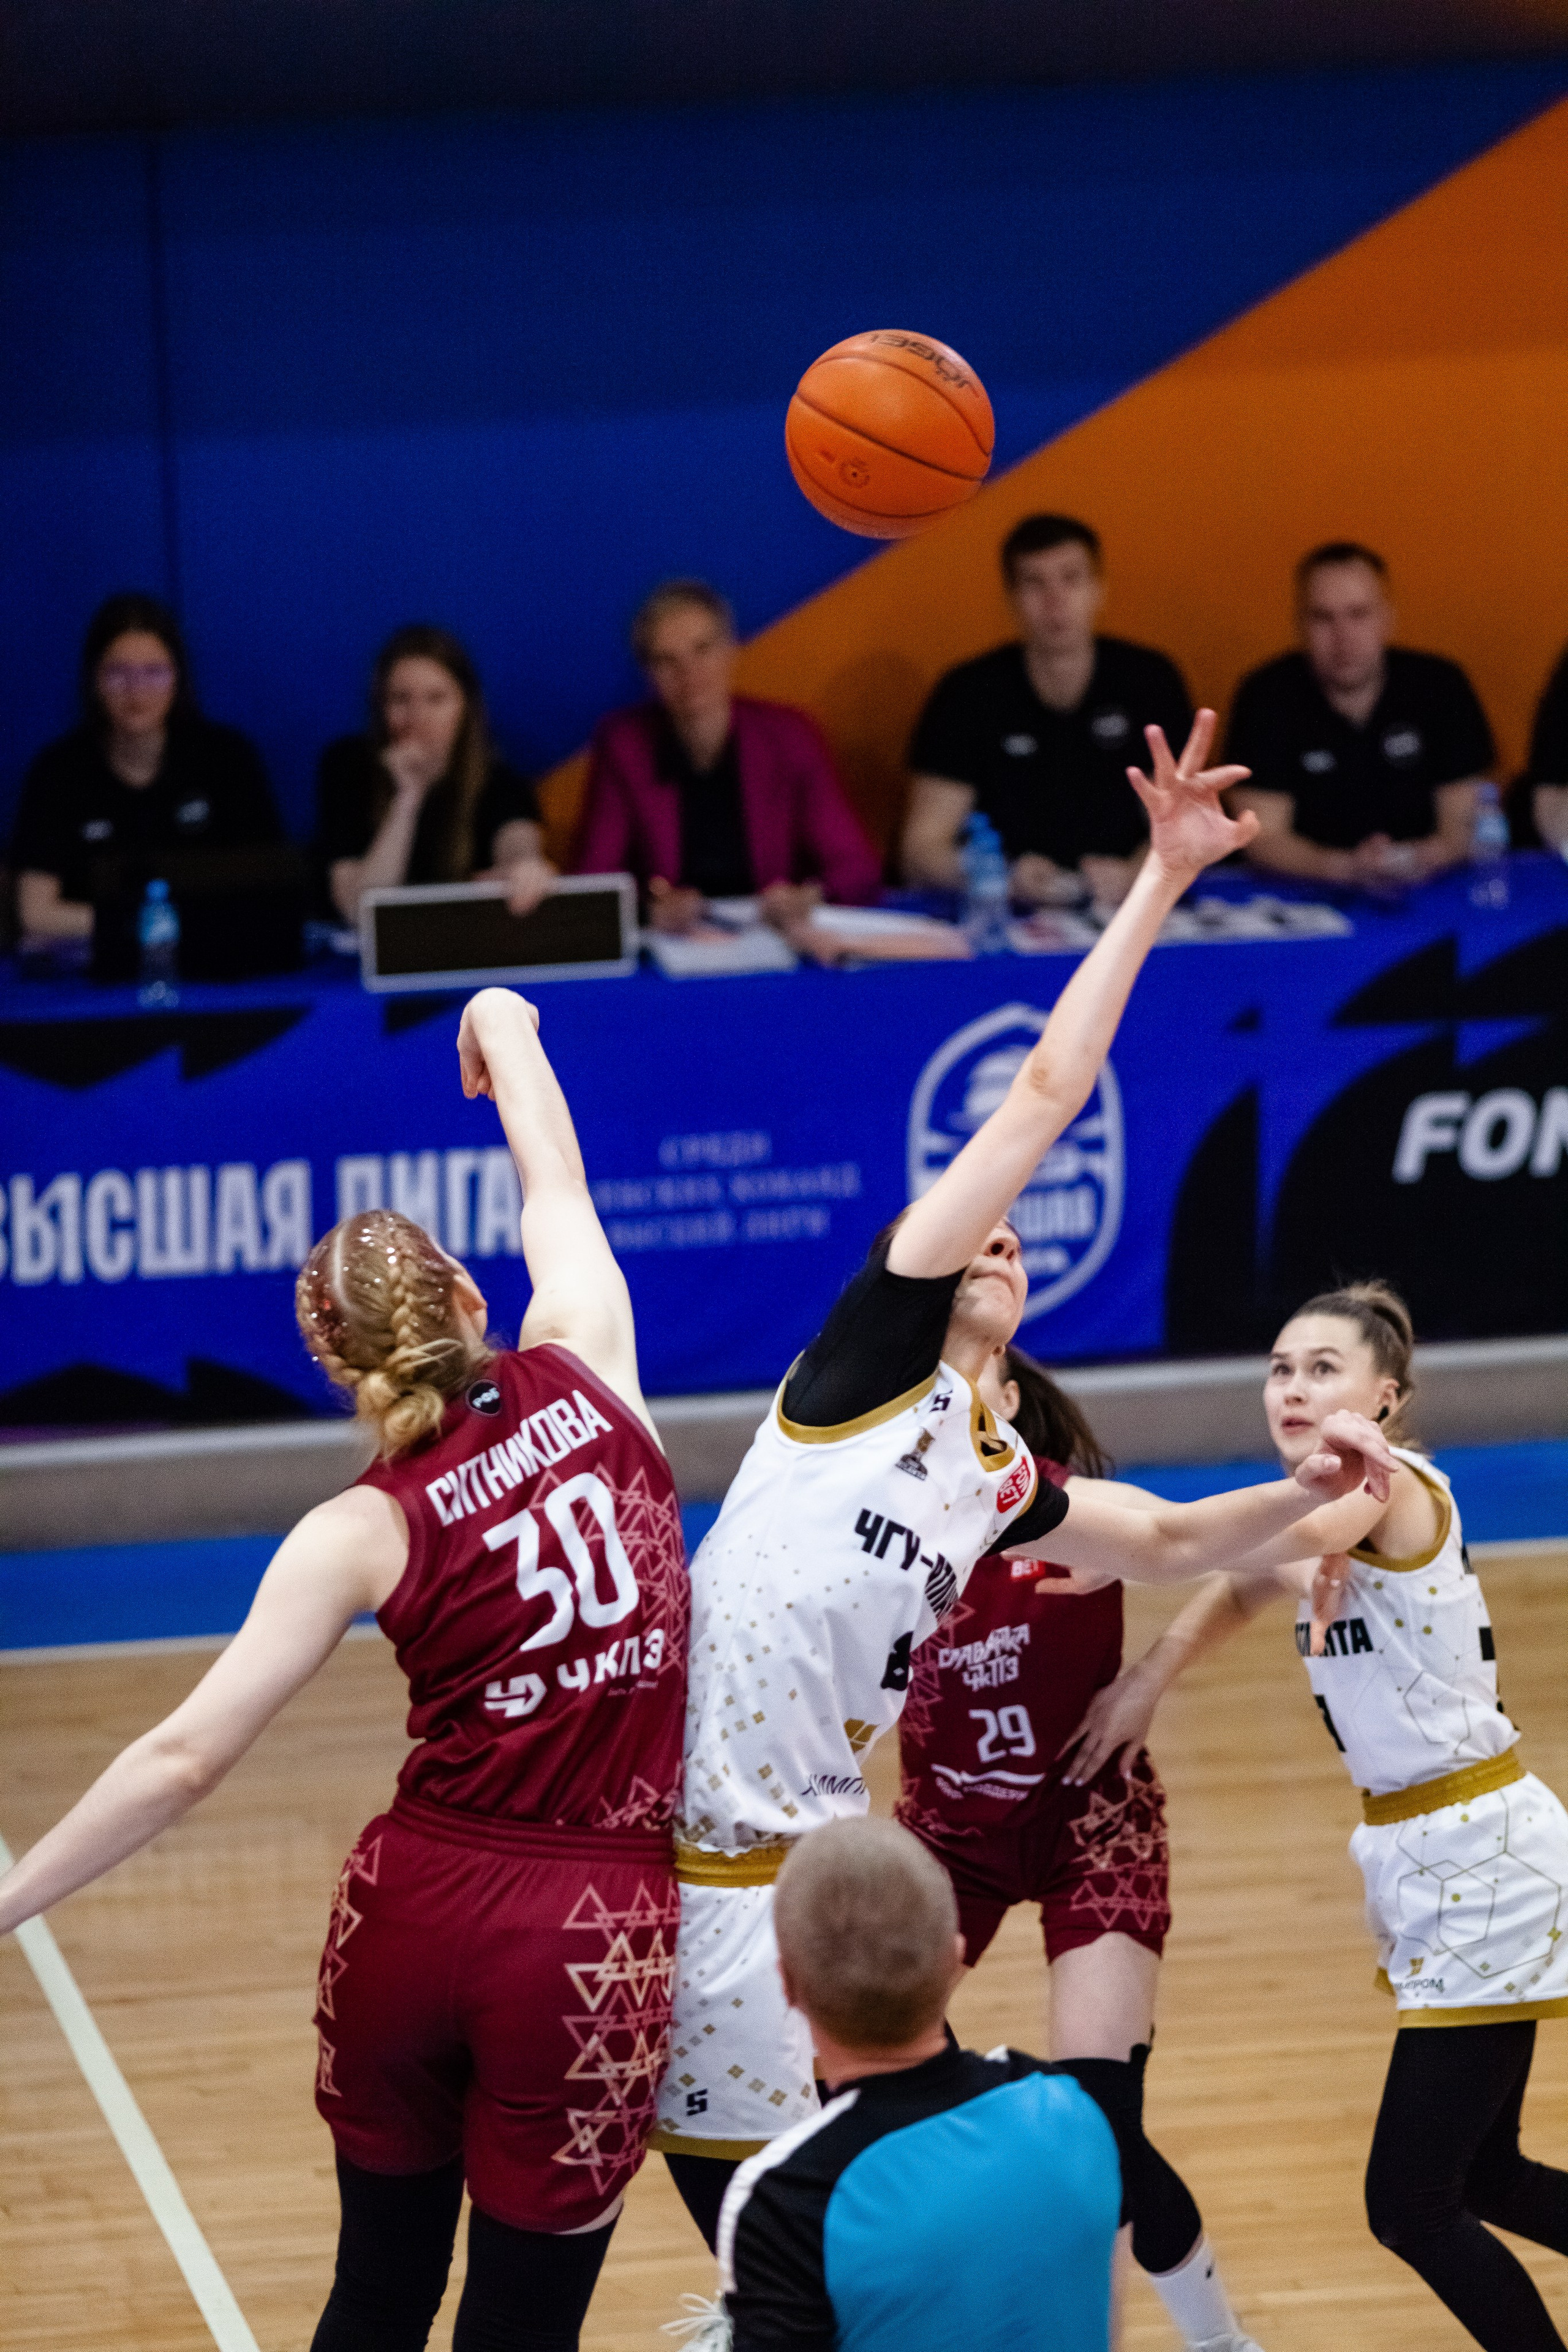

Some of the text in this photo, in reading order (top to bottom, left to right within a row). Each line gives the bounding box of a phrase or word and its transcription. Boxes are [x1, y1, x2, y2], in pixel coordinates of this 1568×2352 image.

[426, 1389, 614, 1526] СИТНИКОВА
[482, 1472, 639, 1652] 30
[968, 1704, 1037, 1764] 29
